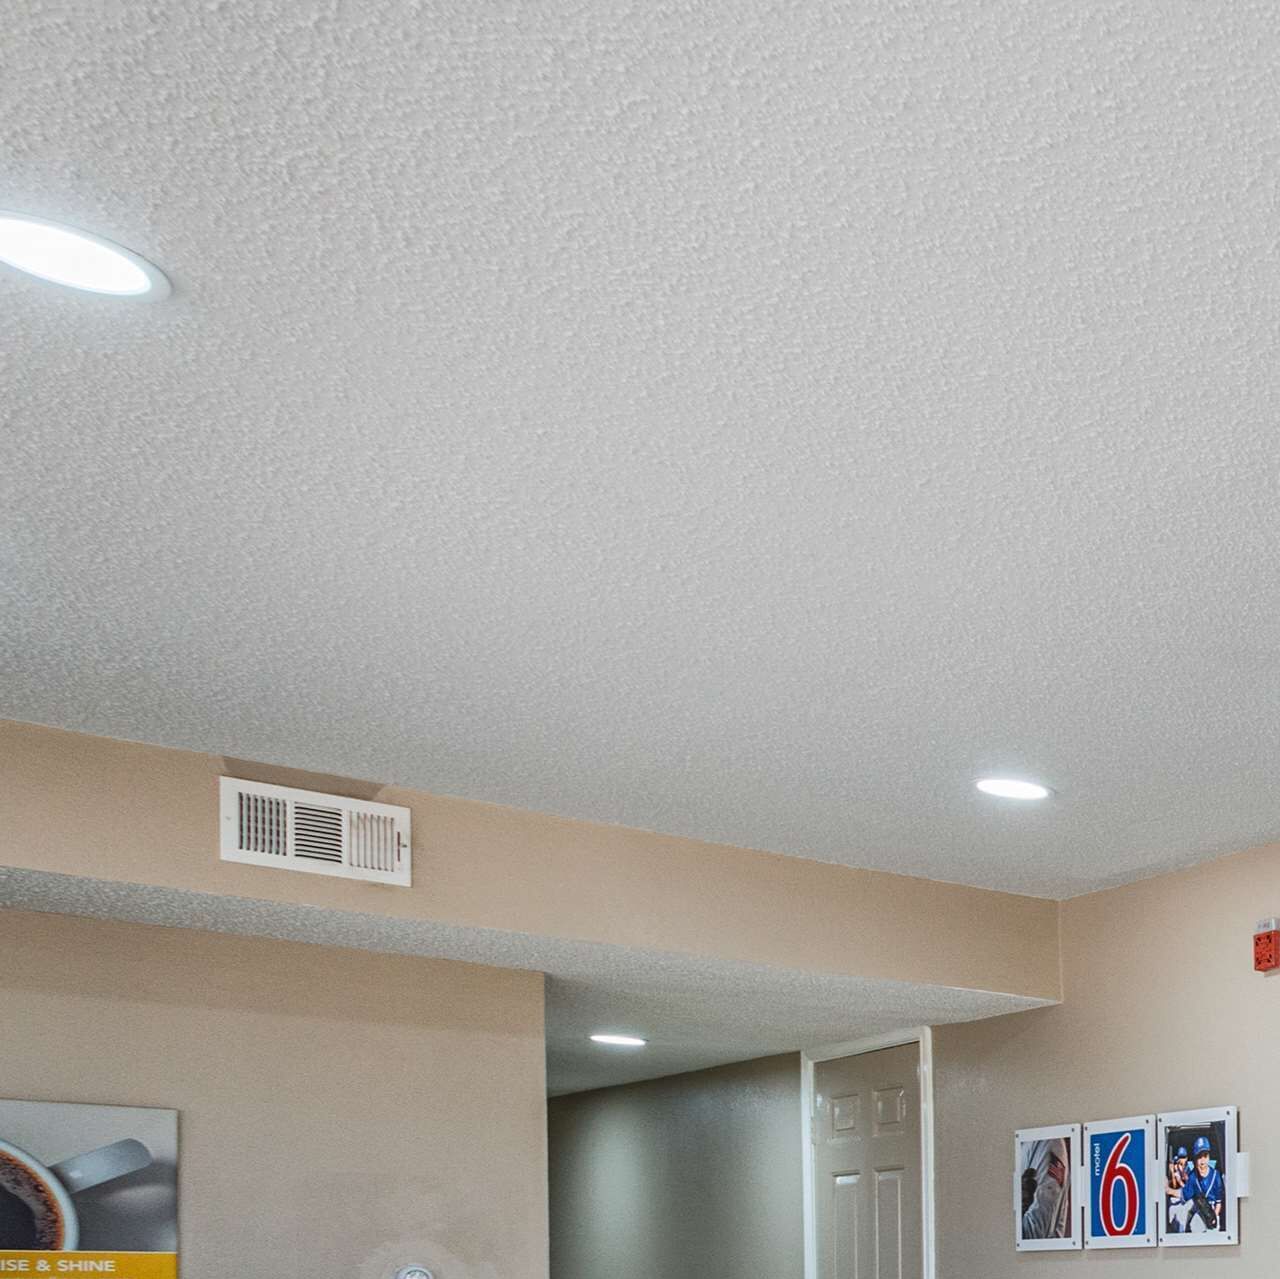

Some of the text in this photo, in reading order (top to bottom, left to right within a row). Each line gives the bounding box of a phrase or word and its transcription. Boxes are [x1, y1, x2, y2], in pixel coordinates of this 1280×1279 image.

[1099, 1132, 1139, 1236] 6
[0, 1259, 116, 1272] ISE & SHINE
